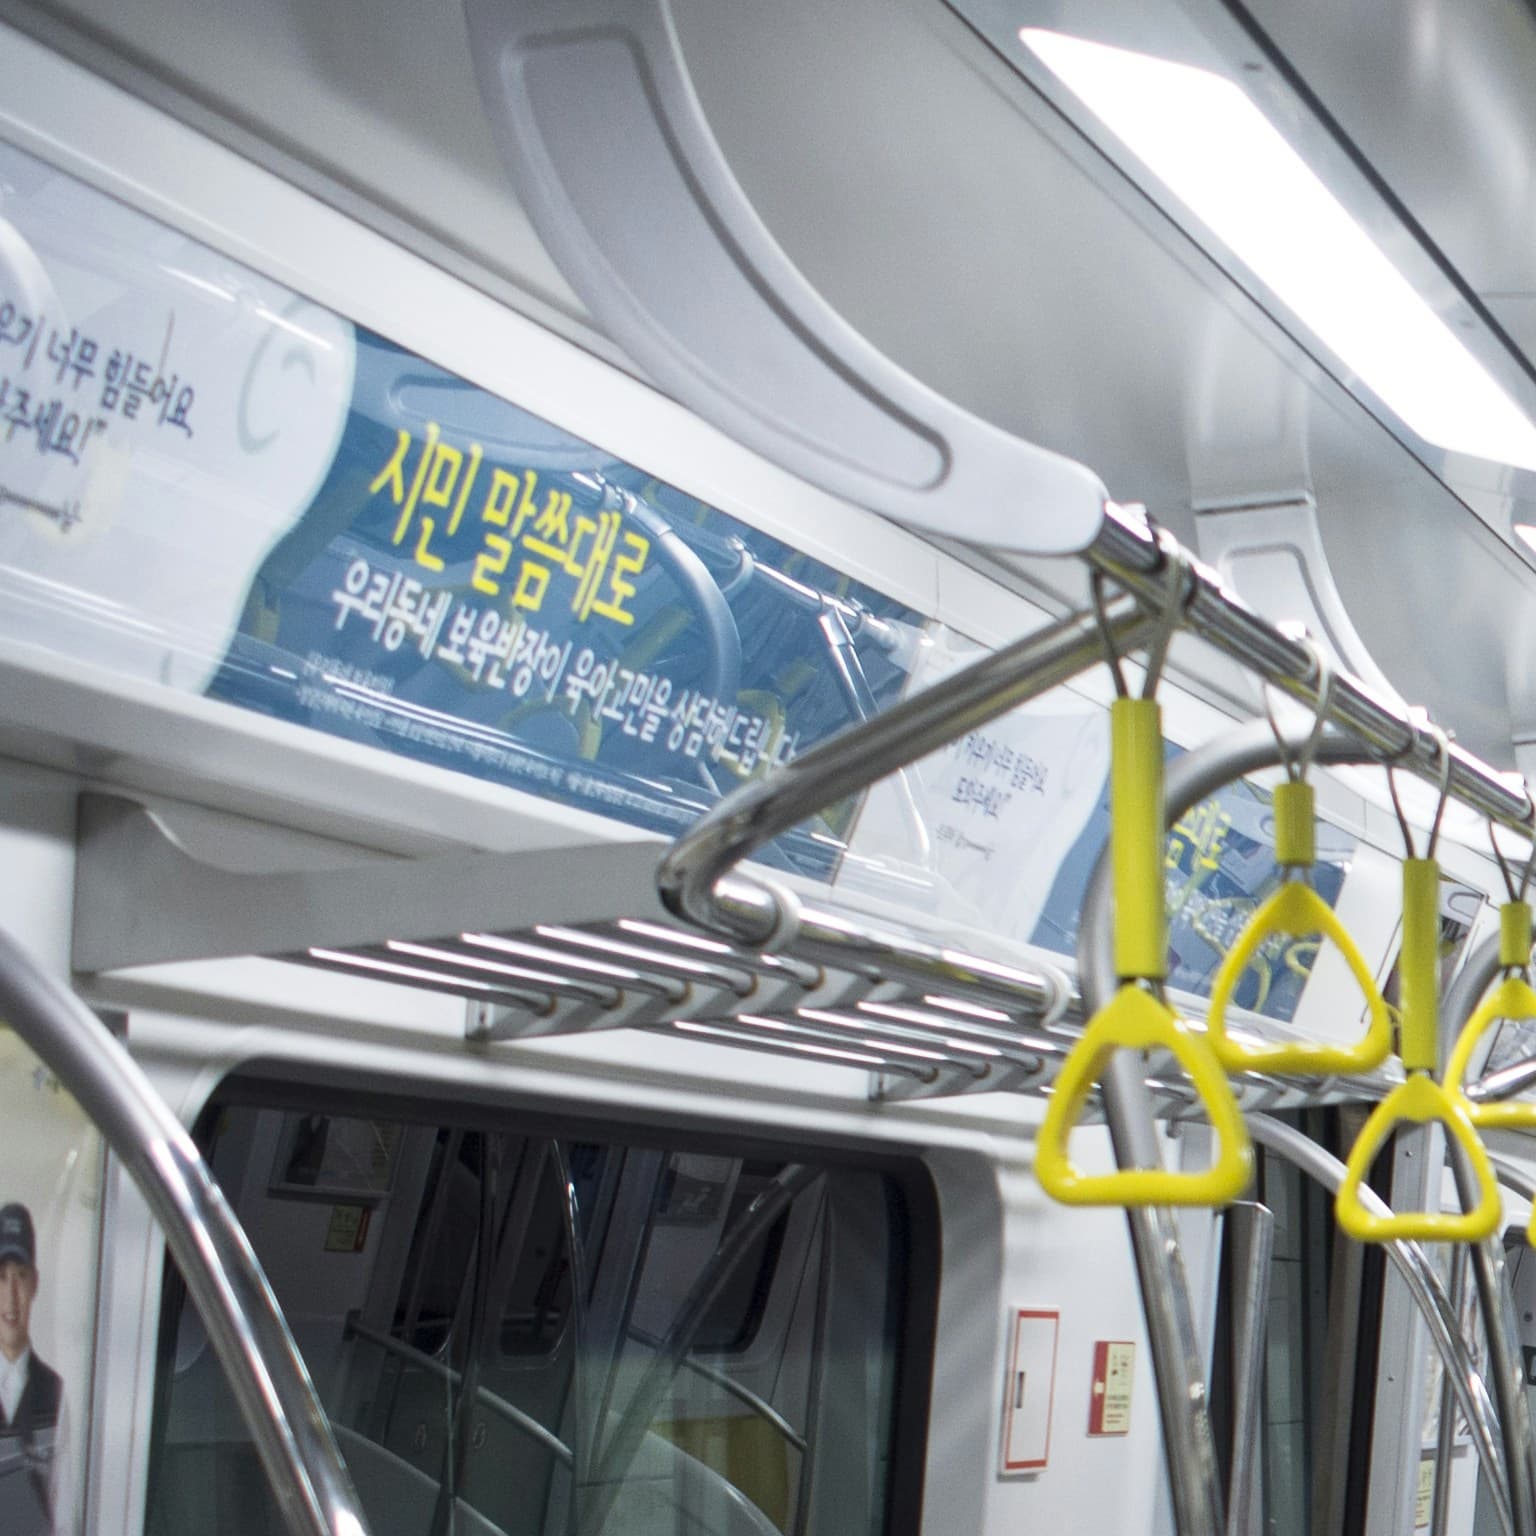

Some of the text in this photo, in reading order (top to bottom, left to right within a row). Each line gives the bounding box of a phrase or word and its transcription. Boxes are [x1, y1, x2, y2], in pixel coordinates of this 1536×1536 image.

[47, 328, 98, 391] 너무
[369, 421, 651, 626] 시민 말씀대로
[332, 557, 454, 661] 우리동네
[437, 604, 573, 705] 보육반장이
[565, 648, 674, 744] 육아고민을
